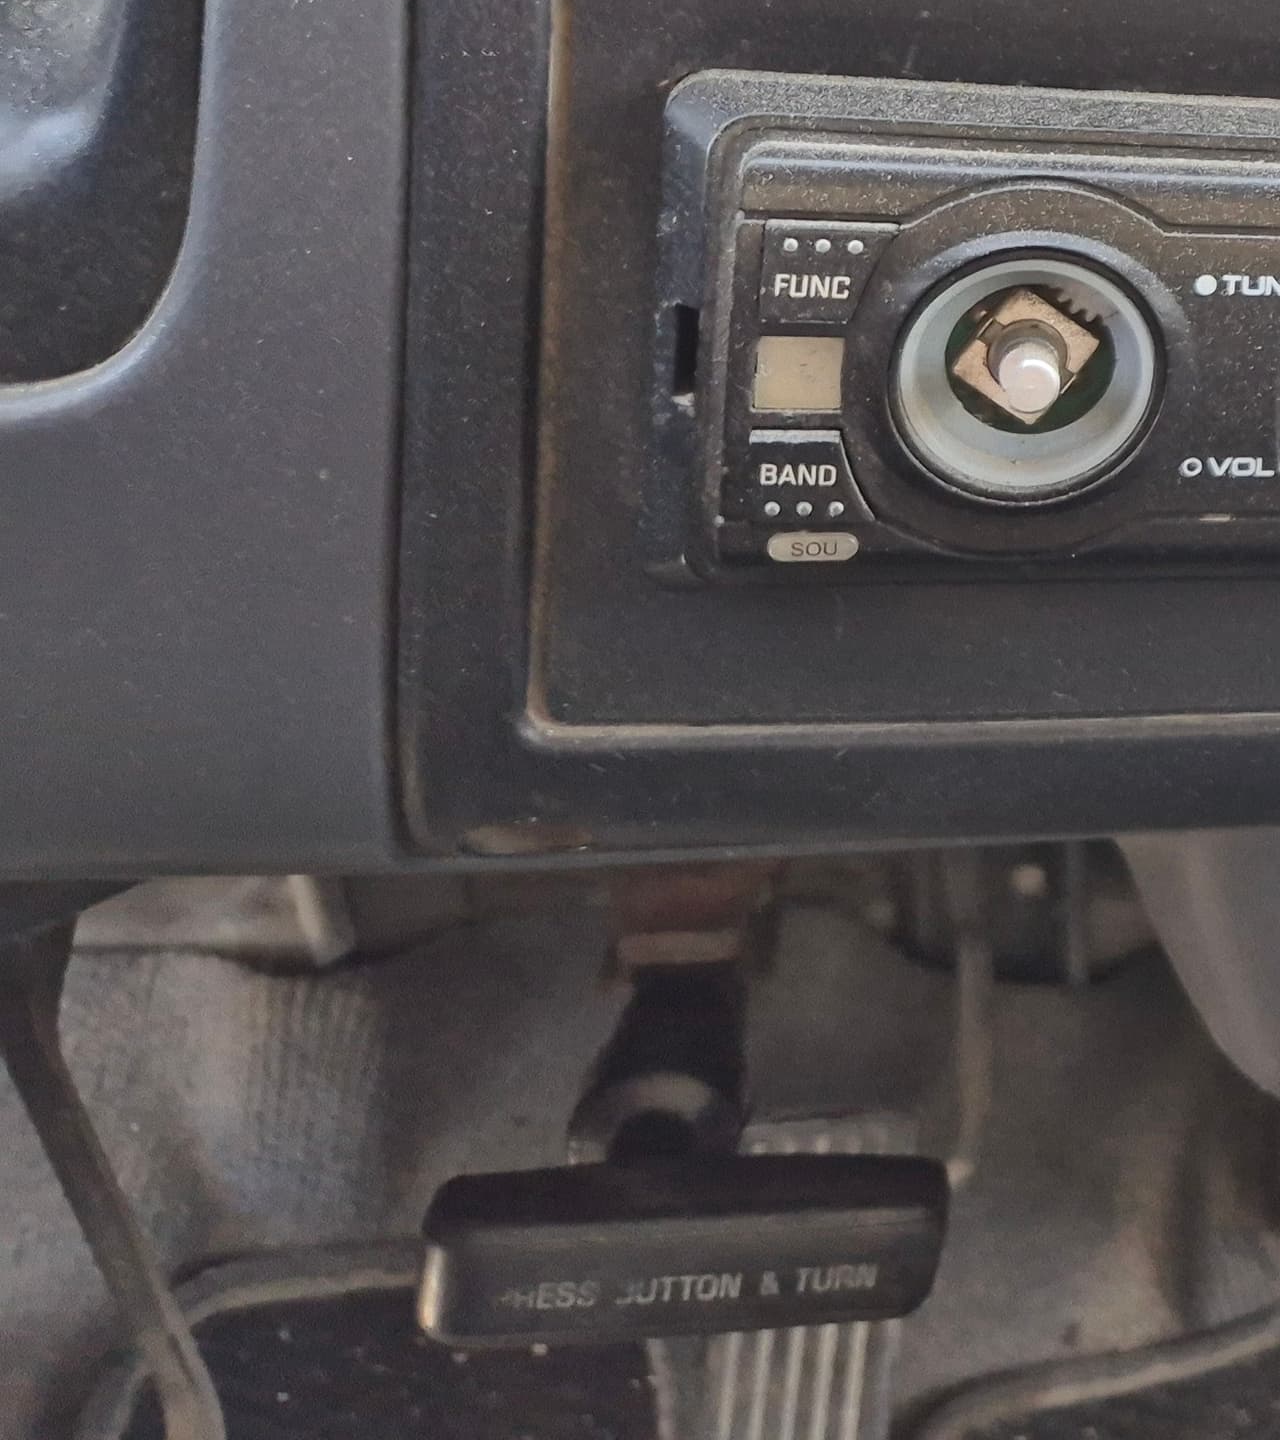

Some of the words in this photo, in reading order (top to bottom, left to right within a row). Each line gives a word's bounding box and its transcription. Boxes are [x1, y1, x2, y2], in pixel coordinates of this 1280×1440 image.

[774, 273, 850, 300] FUNC
[759, 463, 838, 488] BAND
[1208, 456, 1275, 478] VOL
[790, 541, 839, 558] SOU
[796, 1262, 880, 1294] TURN
